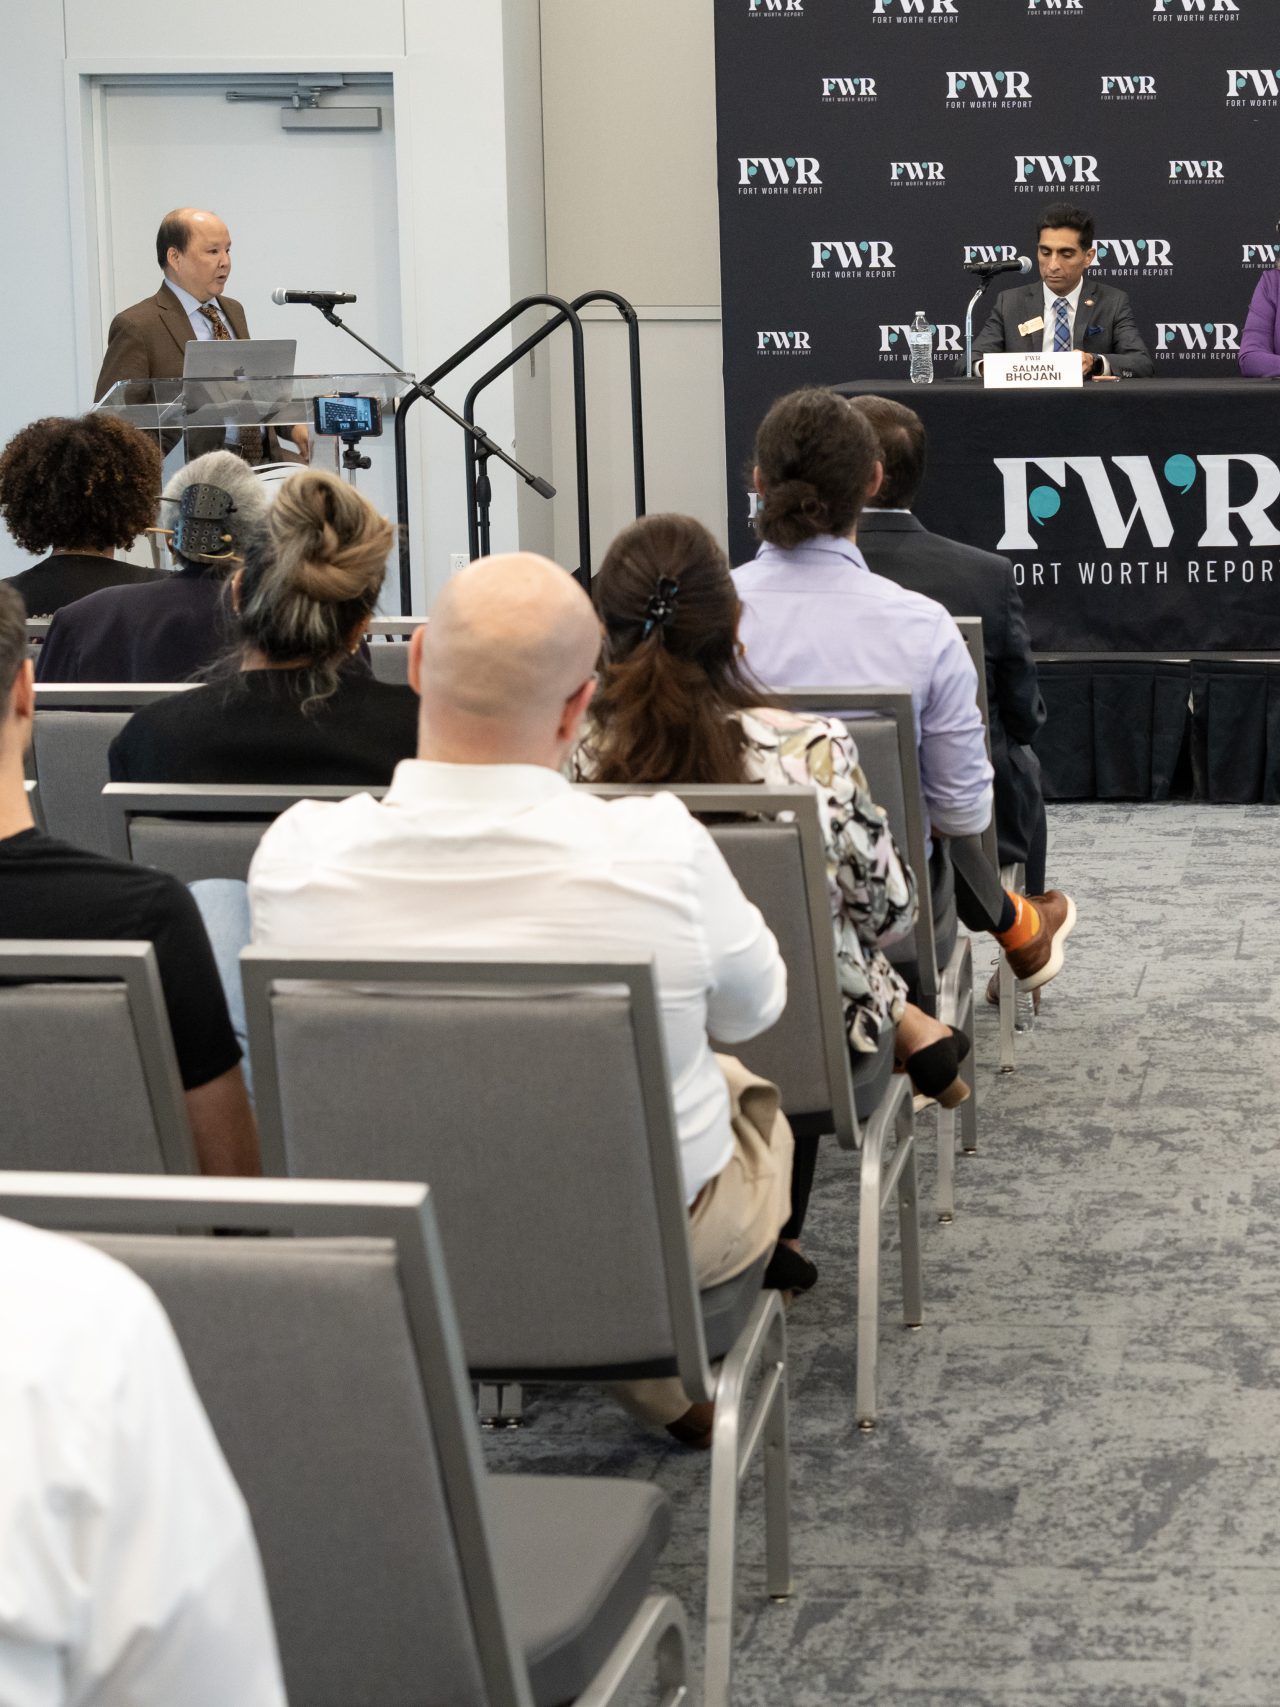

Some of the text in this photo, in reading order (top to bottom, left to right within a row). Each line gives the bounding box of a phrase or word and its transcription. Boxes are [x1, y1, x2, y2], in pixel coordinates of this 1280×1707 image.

[872, 15, 959, 24] FORT WORTH REPORT
[1152, 13, 1240, 22] FORT WORTH REPORT
[822, 78, 877, 95] FWR
[946, 71, 1032, 98] FWR
[1101, 76, 1156, 93] FWR
[945, 100, 1033, 109] FORT WORTH REPORT
[1225, 98, 1247, 107] FORT
[1249, 98, 1278, 107] WORTH
[738, 158, 822, 184] FWR
[891, 162, 945, 179] FWR
[1015, 156, 1100, 182] FWR
[1169, 161, 1224, 178] FWR
[738, 186, 823, 195] FORT WORTH REPORT
[1013, 184, 1101, 193] FORT WORTH REPORT
[811, 241, 896, 268] FWR
[964, 245, 1017, 264] FWR
[1090, 239, 1174, 266] FWR
[811, 270, 896, 279] FORT WORTH REPORT
[1087, 268, 1174, 277] FORT WORTH REPORT
[757, 332, 811, 348] FWR
[1155, 323, 1240, 350] FWR
[878, 353, 899, 361] FORT
[1155, 352, 1175, 360] FORT
[1179, 352, 1206, 360] WORTH
[1012, 364, 1054, 372] SALMAN
[1006, 372, 1062, 382] BHOJANI
[1012, 562, 1062, 586] ORT
[1078, 561, 1168, 585] WORTH
